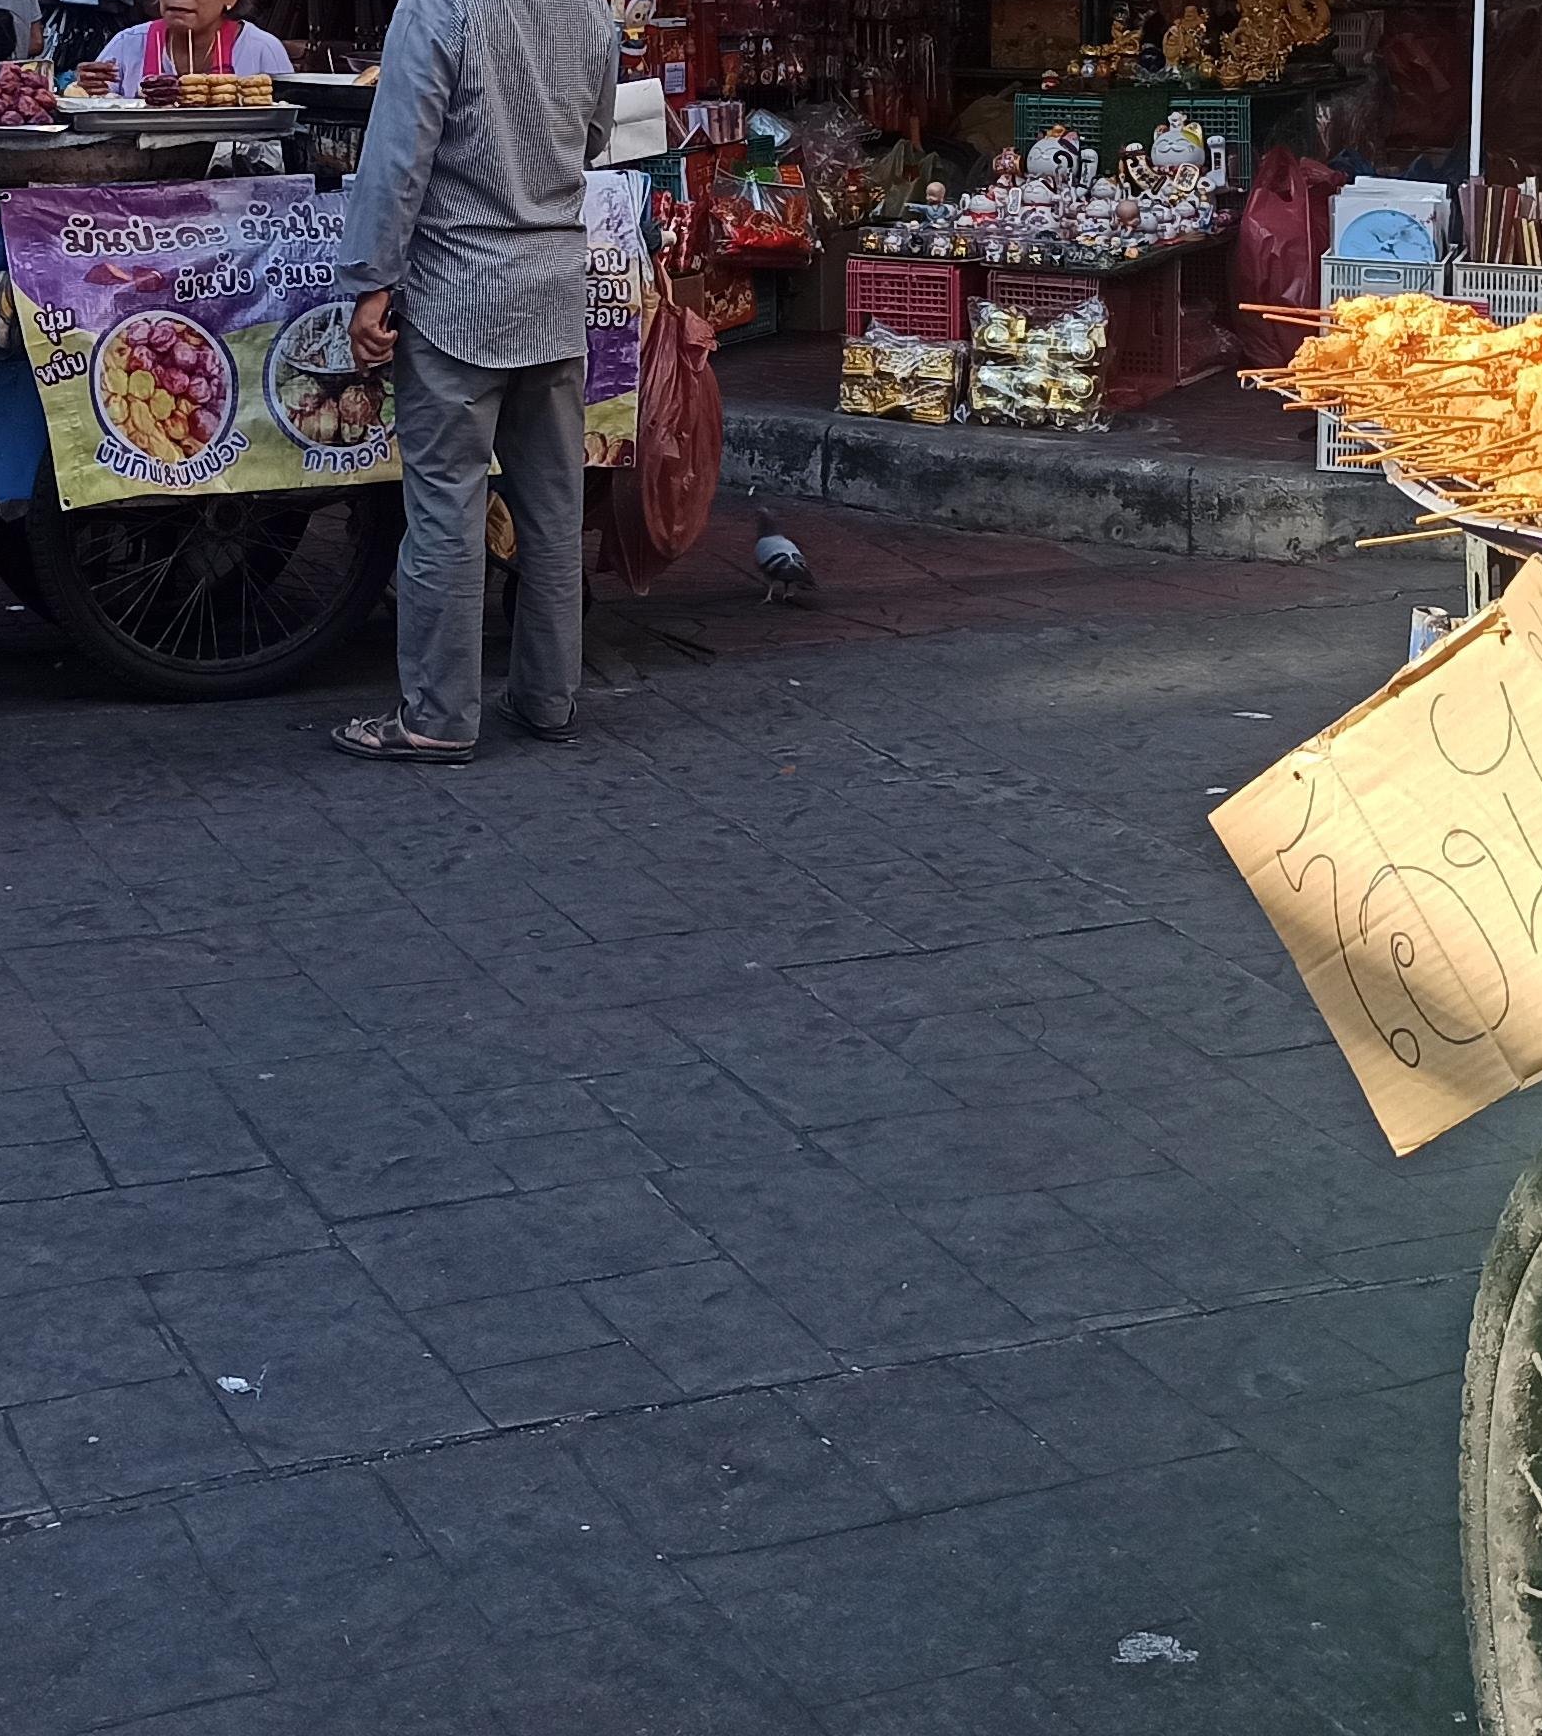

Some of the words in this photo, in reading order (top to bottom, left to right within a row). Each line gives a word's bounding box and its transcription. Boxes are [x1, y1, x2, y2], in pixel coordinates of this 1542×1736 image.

[175, 253, 254, 302] มันปิ้ง
[35, 304, 72, 342] นุ่ม
